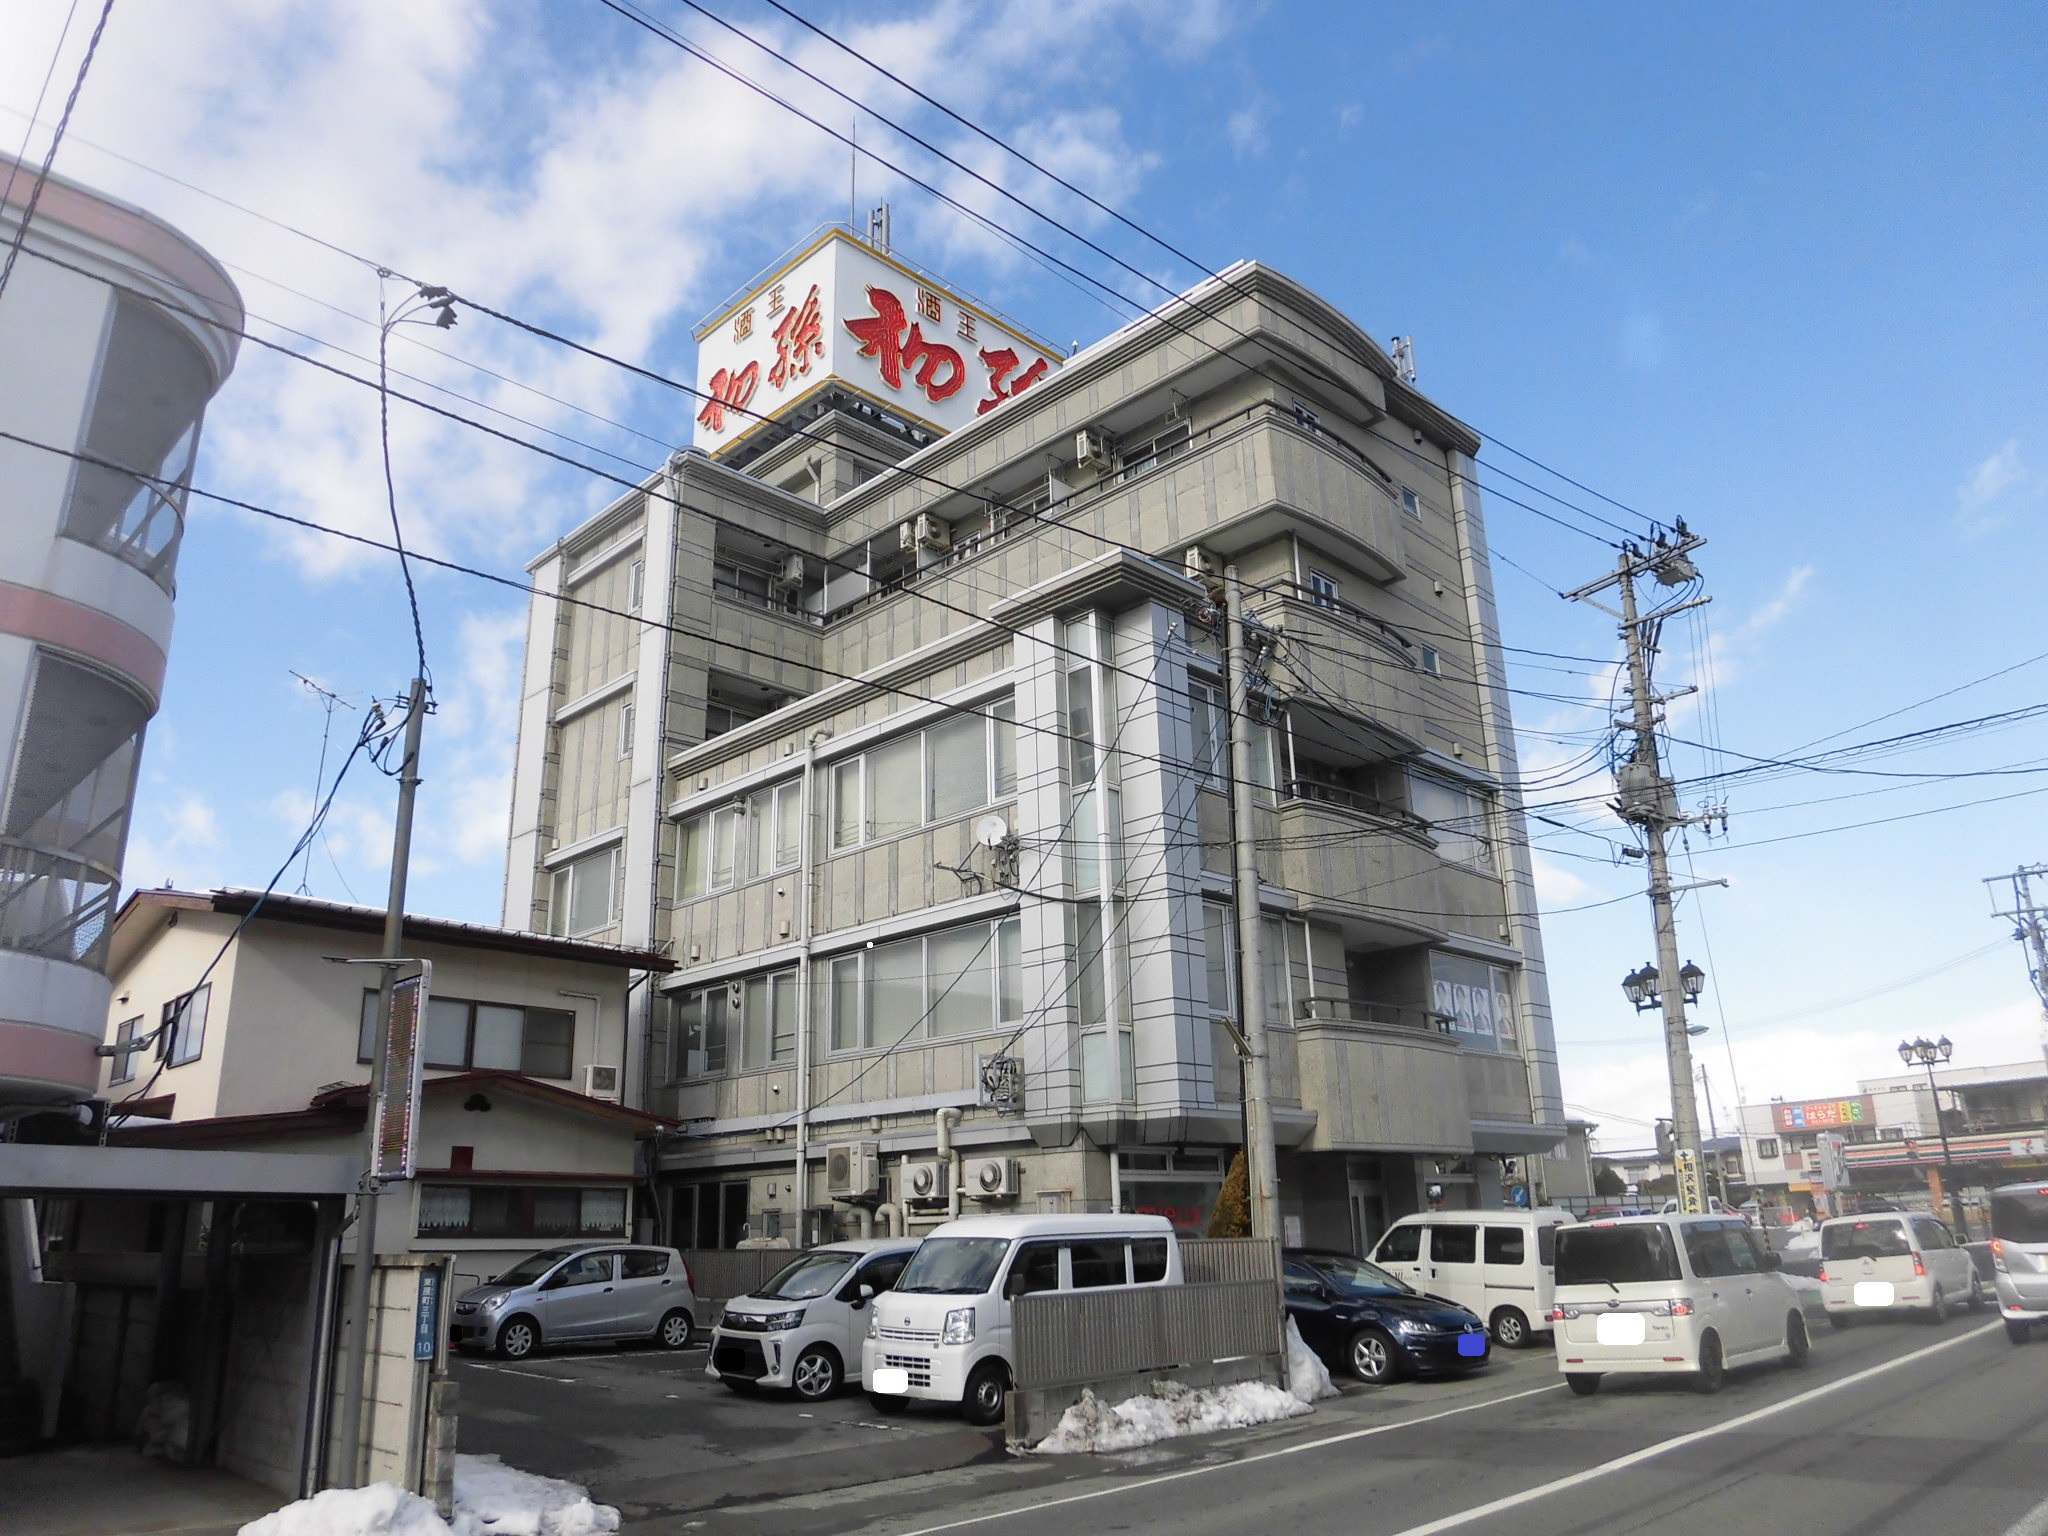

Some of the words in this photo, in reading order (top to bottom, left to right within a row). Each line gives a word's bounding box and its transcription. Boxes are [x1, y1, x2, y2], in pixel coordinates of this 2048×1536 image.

[733, 284, 785, 343] 酒王
[917, 288, 978, 342] 酒王
[1806, 1110, 1837, 1119] はらだ
[420, 1278, 432, 1333] 東原町三丁目
[417, 1341, 431, 1353] 10
